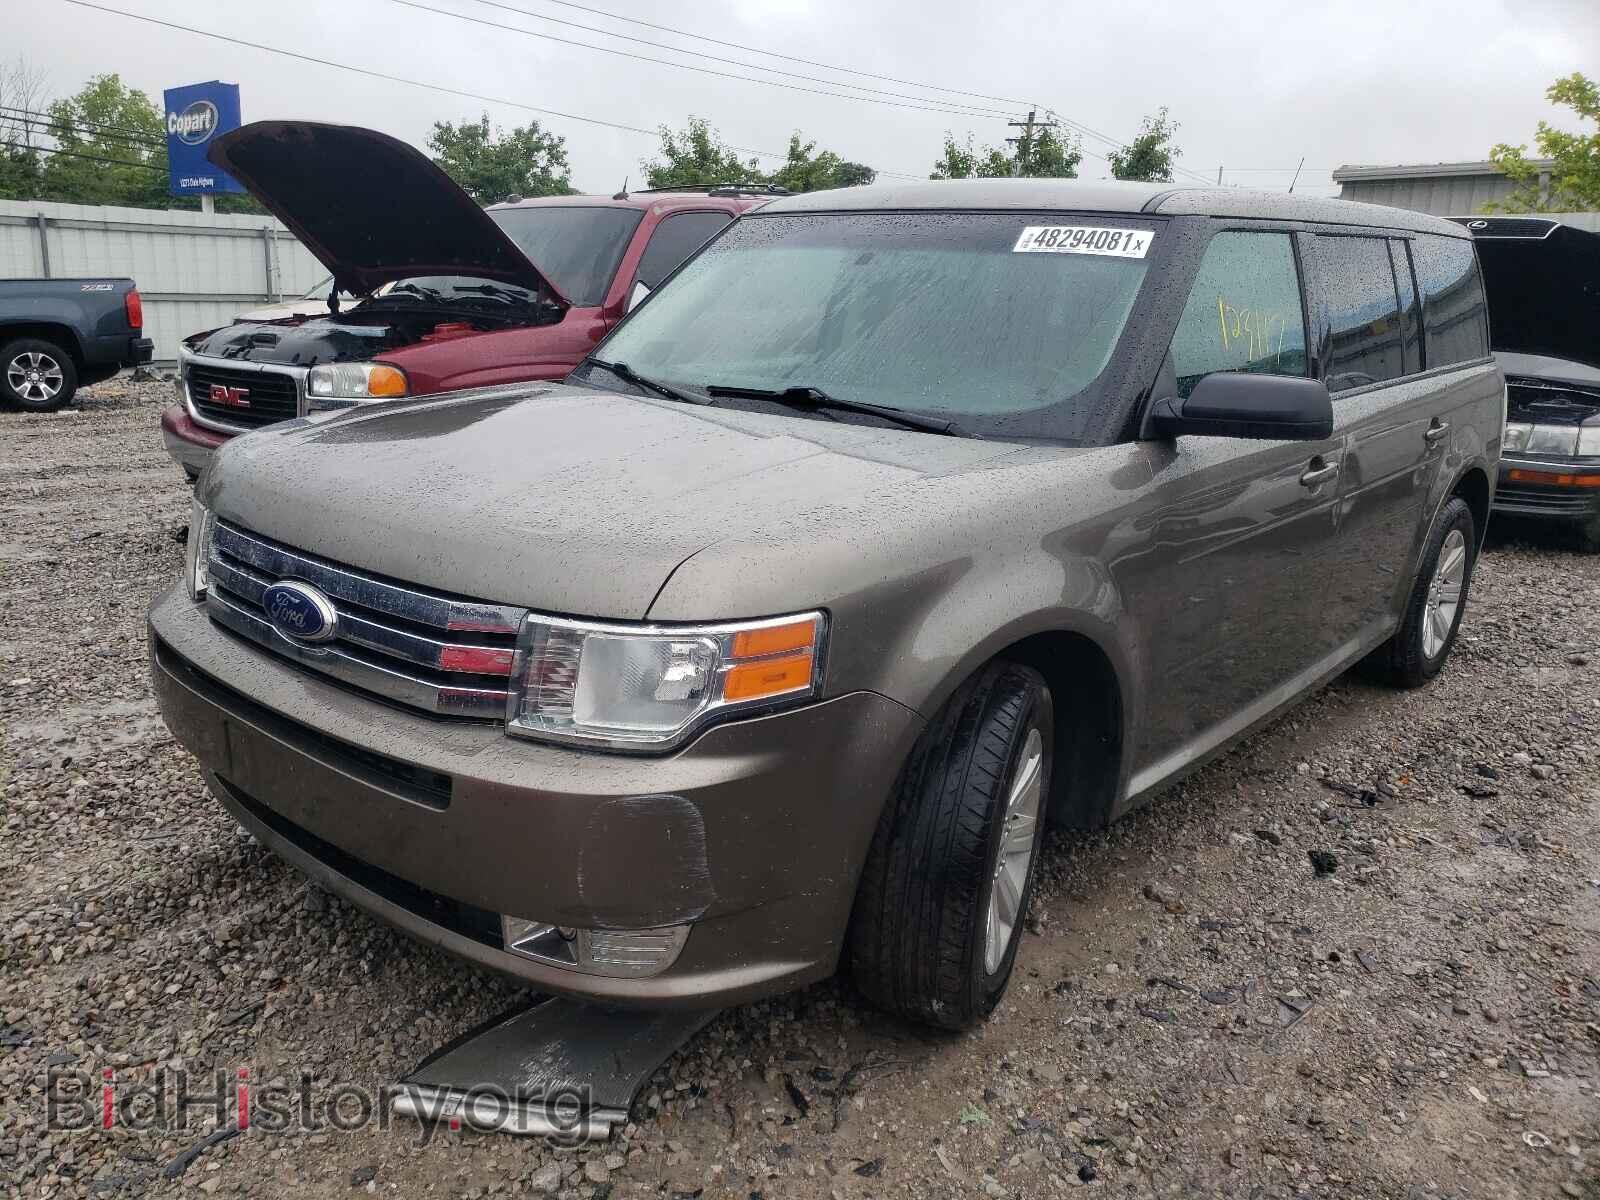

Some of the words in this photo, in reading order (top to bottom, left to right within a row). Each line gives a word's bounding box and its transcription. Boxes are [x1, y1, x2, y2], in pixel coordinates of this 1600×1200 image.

[168, 109, 212, 136] Copart
[1033, 228, 1134, 252] 48294081
[209, 384, 250, 407] GMC
[271, 591, 307, 628] Ford
